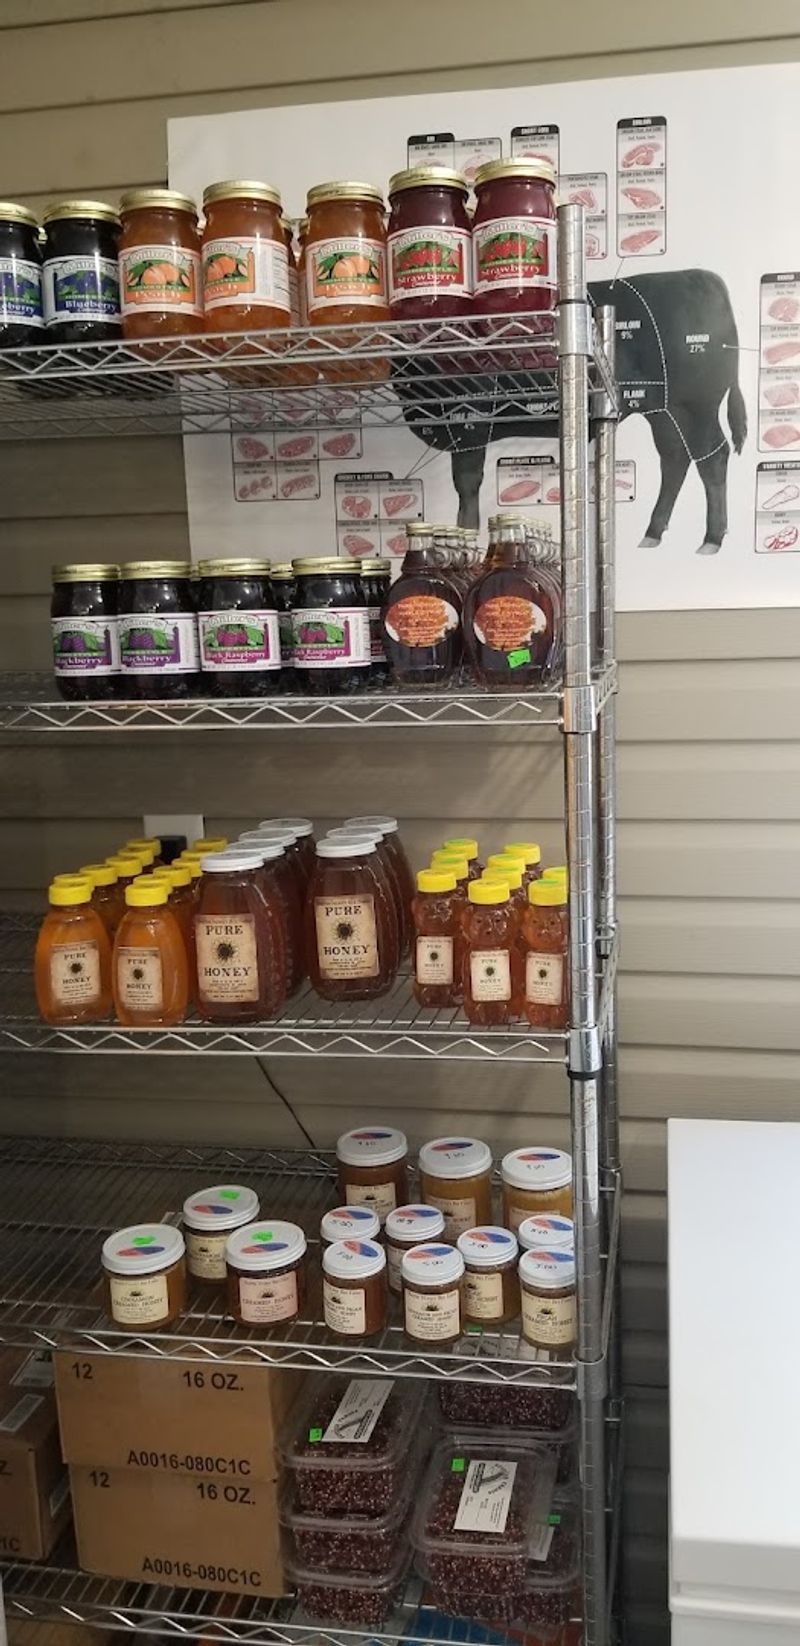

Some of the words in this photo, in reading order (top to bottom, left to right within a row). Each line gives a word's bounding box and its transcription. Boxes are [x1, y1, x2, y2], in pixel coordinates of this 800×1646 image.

[482, 264, 541, 276] Strawberry
[398, 272, 457, 284] Strawberry
[65, 300, 116, 313] Blueberry
[686, 334, 710, 344] ROUND
[690, 344, 705, 353] 27%
[623, 389, 646, 399] FLANK
[225, 650, 265, 660] Raspberry
[325, 905, 362, 917] PURE
[206, 925, 243, 936] PURE
[323, 944, 371, 956] HONEY
[64, 952, 86, 960] PURE
[204, 967, 252, 977] HONEY
[62, 976, 91, 985] HONEY
[141, 1297, 163, 1307] HONEY
[72, 1363, 93, 1379] 12
[183, 1371, 205, 1388] 16
[211, 1373, 244, 1391] OZ.
[128, 1451, 251, 1475] A0016-080C1C
[90, 1471, 110, 1488] 12
[197, 1483, 218, 1500] 16
[224, 1486, 256, 1505] OZ.
[142, 1557, 261, 1587] A0016-080C1C
